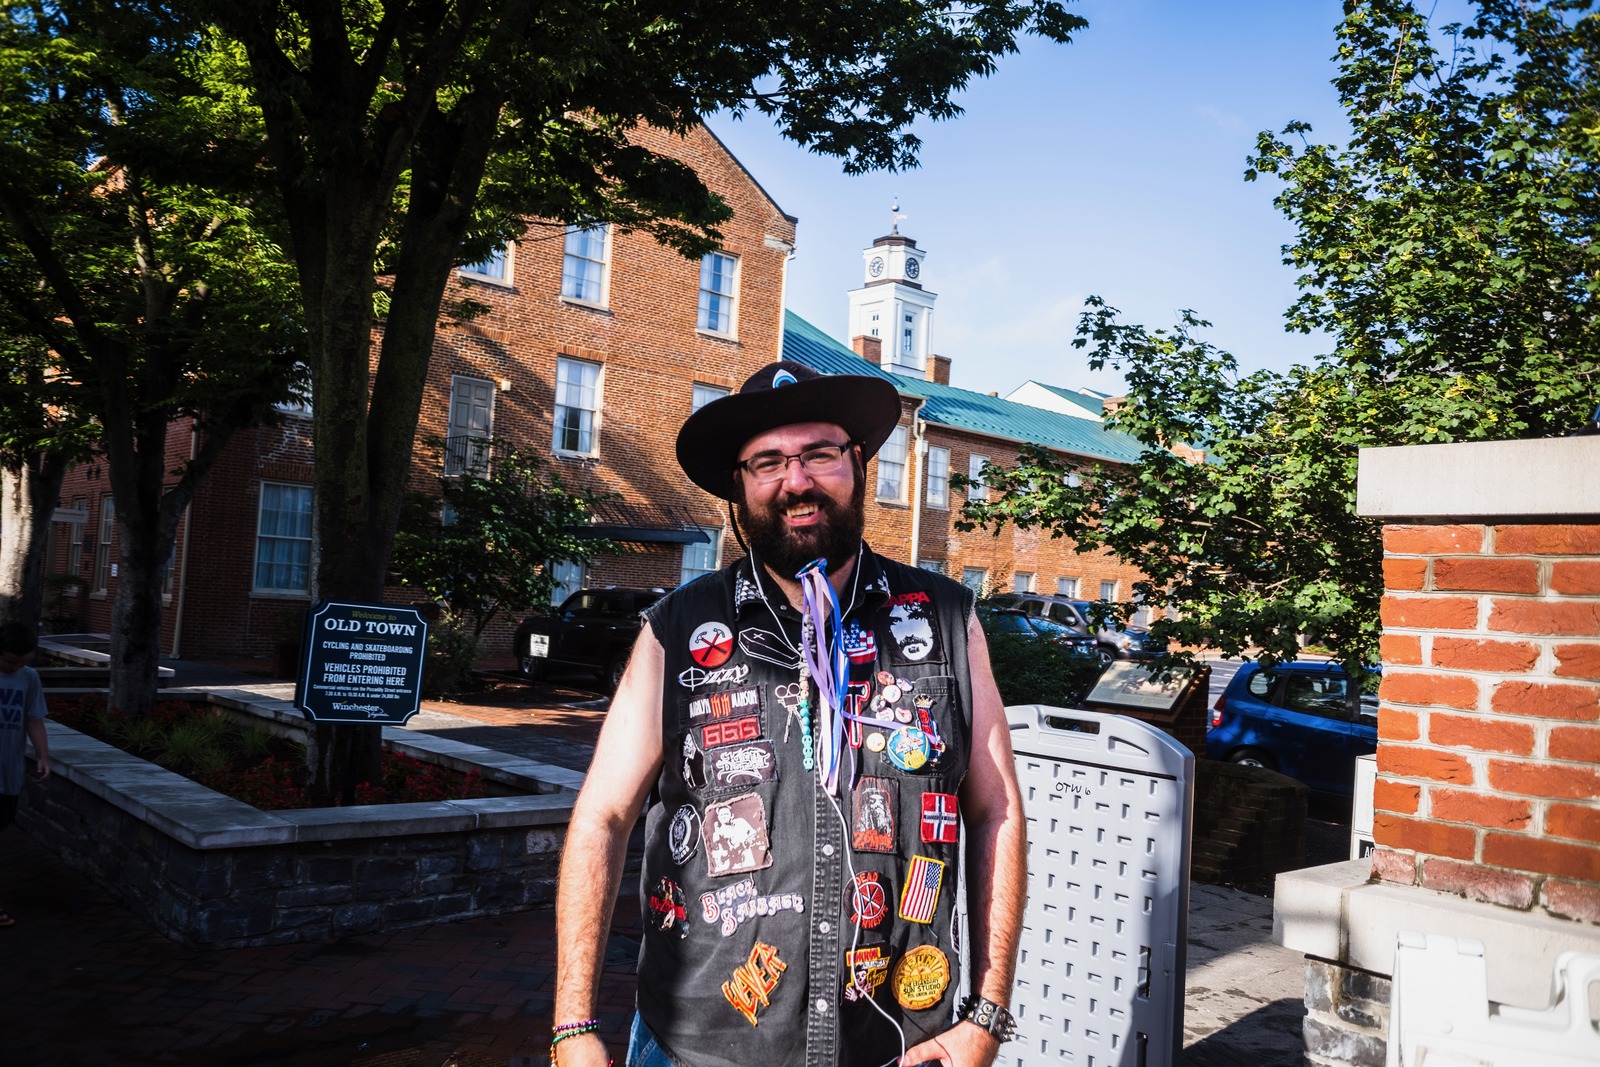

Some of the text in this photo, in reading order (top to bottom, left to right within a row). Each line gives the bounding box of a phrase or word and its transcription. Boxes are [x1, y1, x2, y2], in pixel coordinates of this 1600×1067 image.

[352, 610, 397, 621] Welcome to
[324, 618, 417, 636] OLD TOWN
[323, 640, 413, 654] CYCLING AND SKATEBOARDING
[349, 651, 386, 661] PROHIBITED
[324, 662, 407, 676] VEHICLES PROHIBITED
[323, 673, 405, 686] FROM ENTERING HERE
[332, 702, 380, 712] Winchester
[1055, 782, 1091, 796] OTW 6
[907, 954, 936, 968] SUN
[721, 941, 787, 1027] SLAYER
[917, 983, 941, 992] STUDIO
